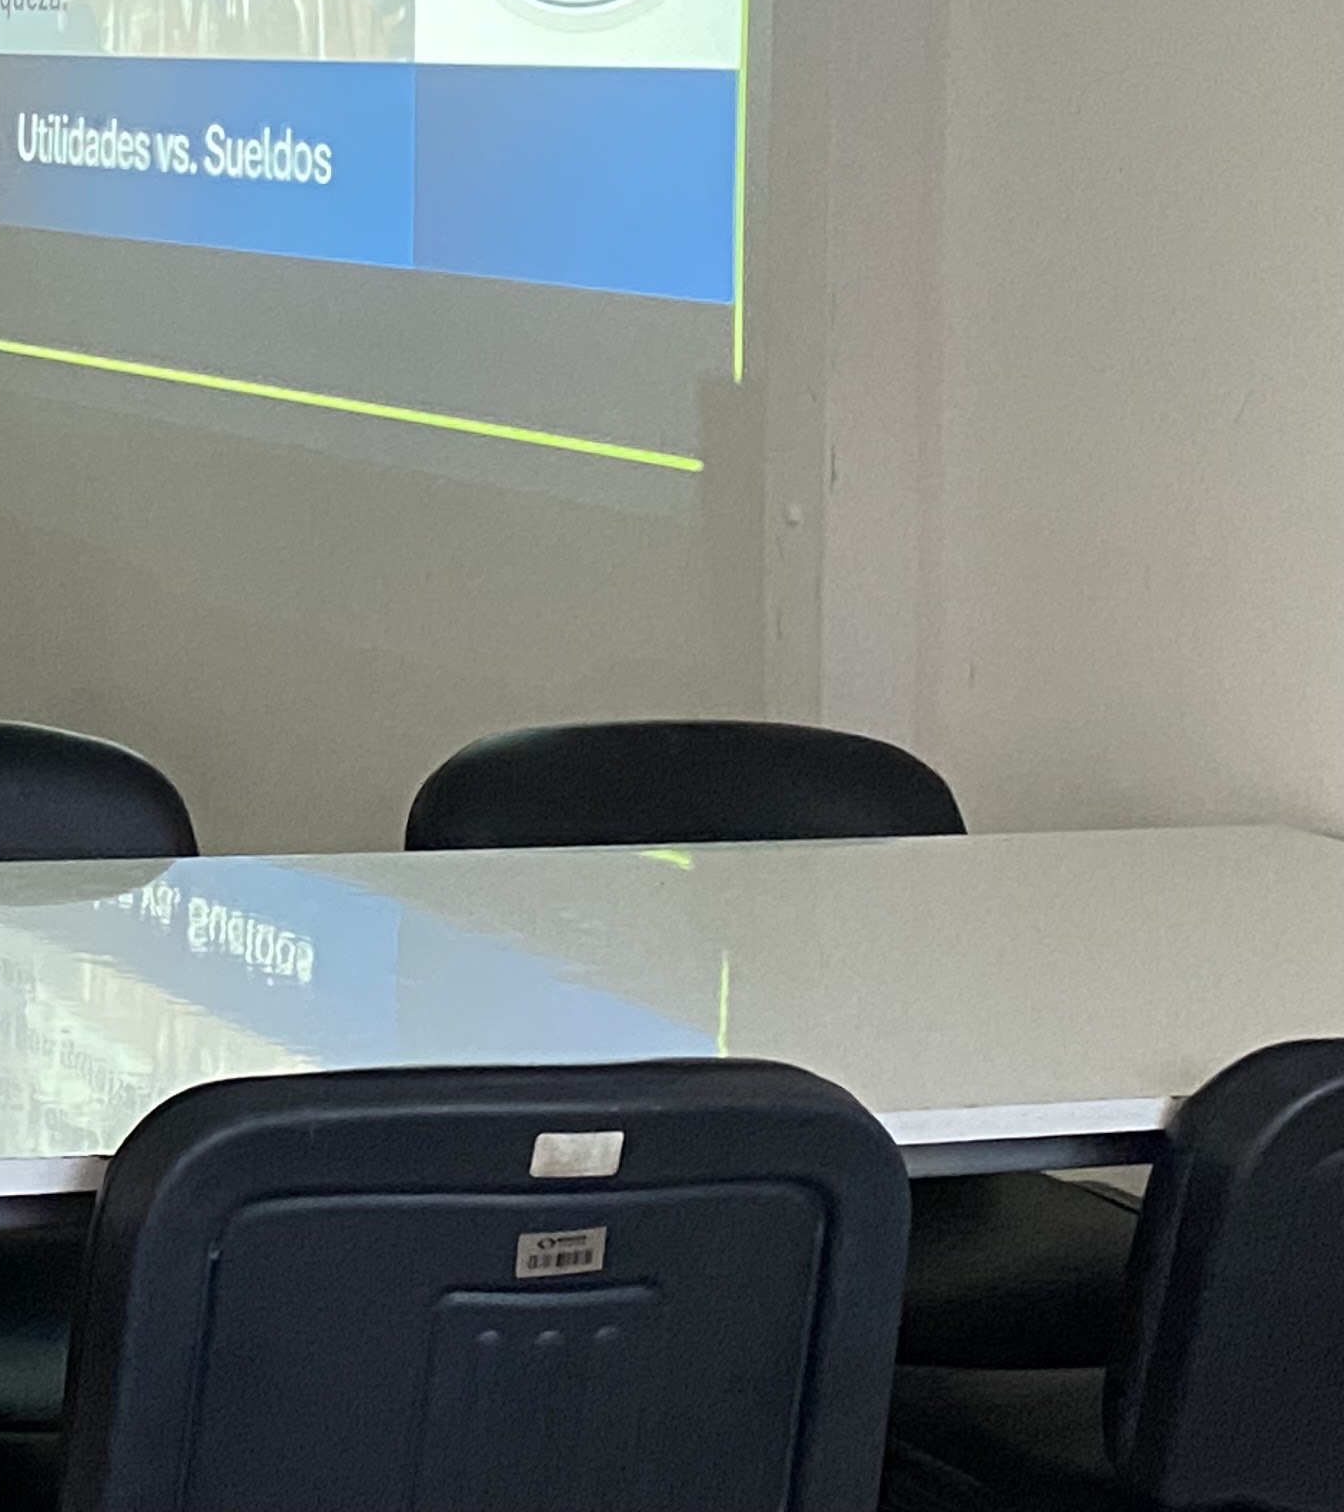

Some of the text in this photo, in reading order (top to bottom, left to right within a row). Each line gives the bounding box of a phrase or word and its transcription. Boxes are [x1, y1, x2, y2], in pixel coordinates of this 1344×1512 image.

[17, 111, 333, 186] Utilidades vs. Sueldos
